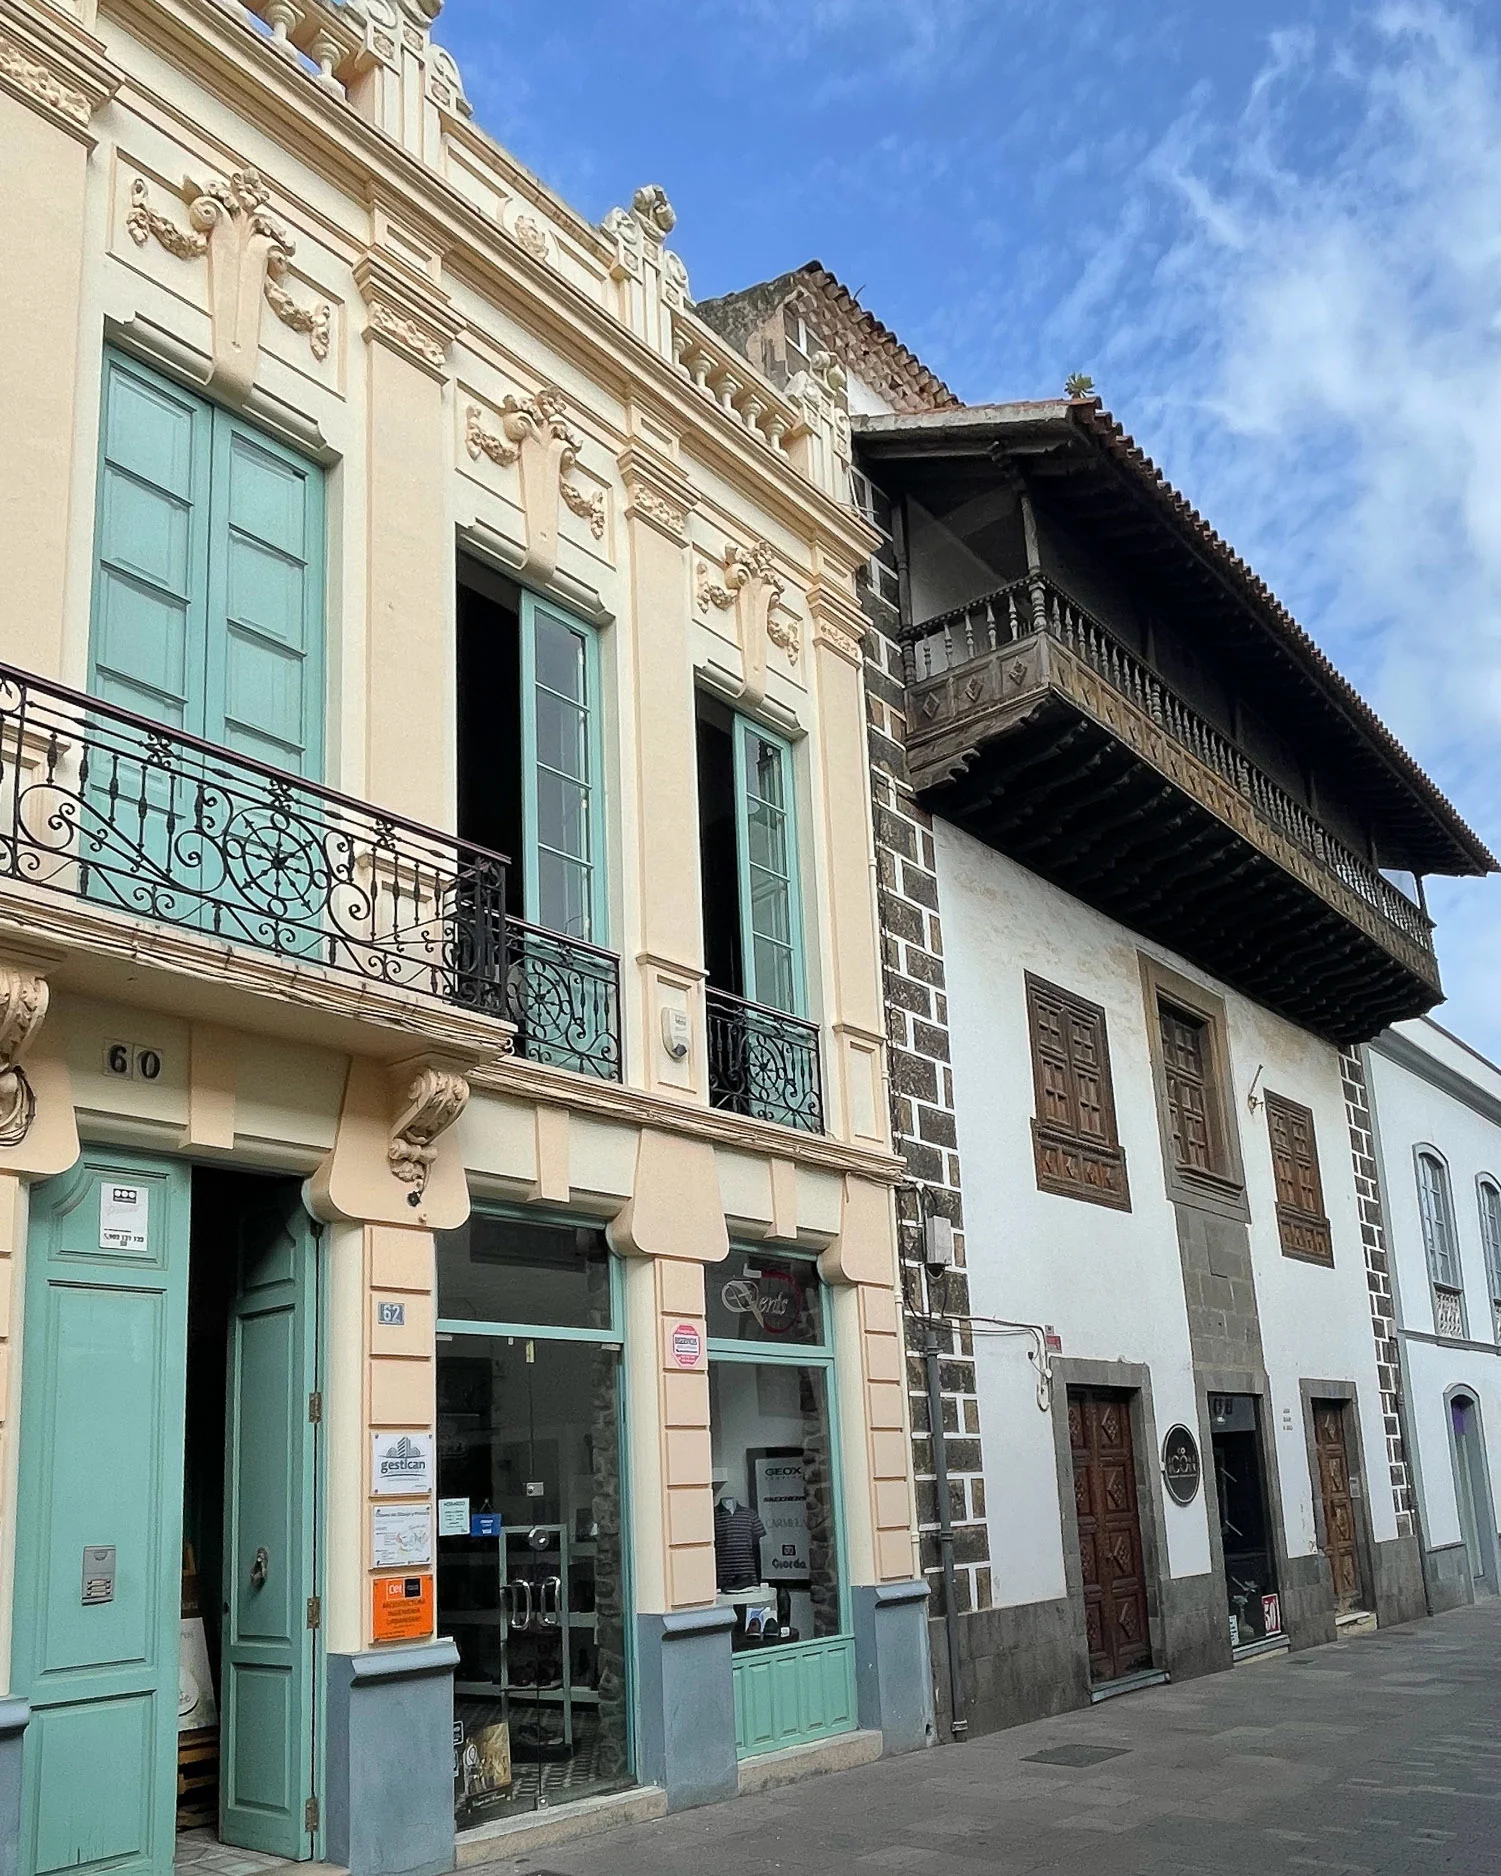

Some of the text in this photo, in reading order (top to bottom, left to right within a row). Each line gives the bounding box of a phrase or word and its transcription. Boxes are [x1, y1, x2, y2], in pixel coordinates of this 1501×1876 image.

[109, 1044, 161, 1079] 60
[383, 1304, 401, 1322] 62
[380, 1458, 426, 1474] gestican
[765, 1467, 801, 1476] GEOX
